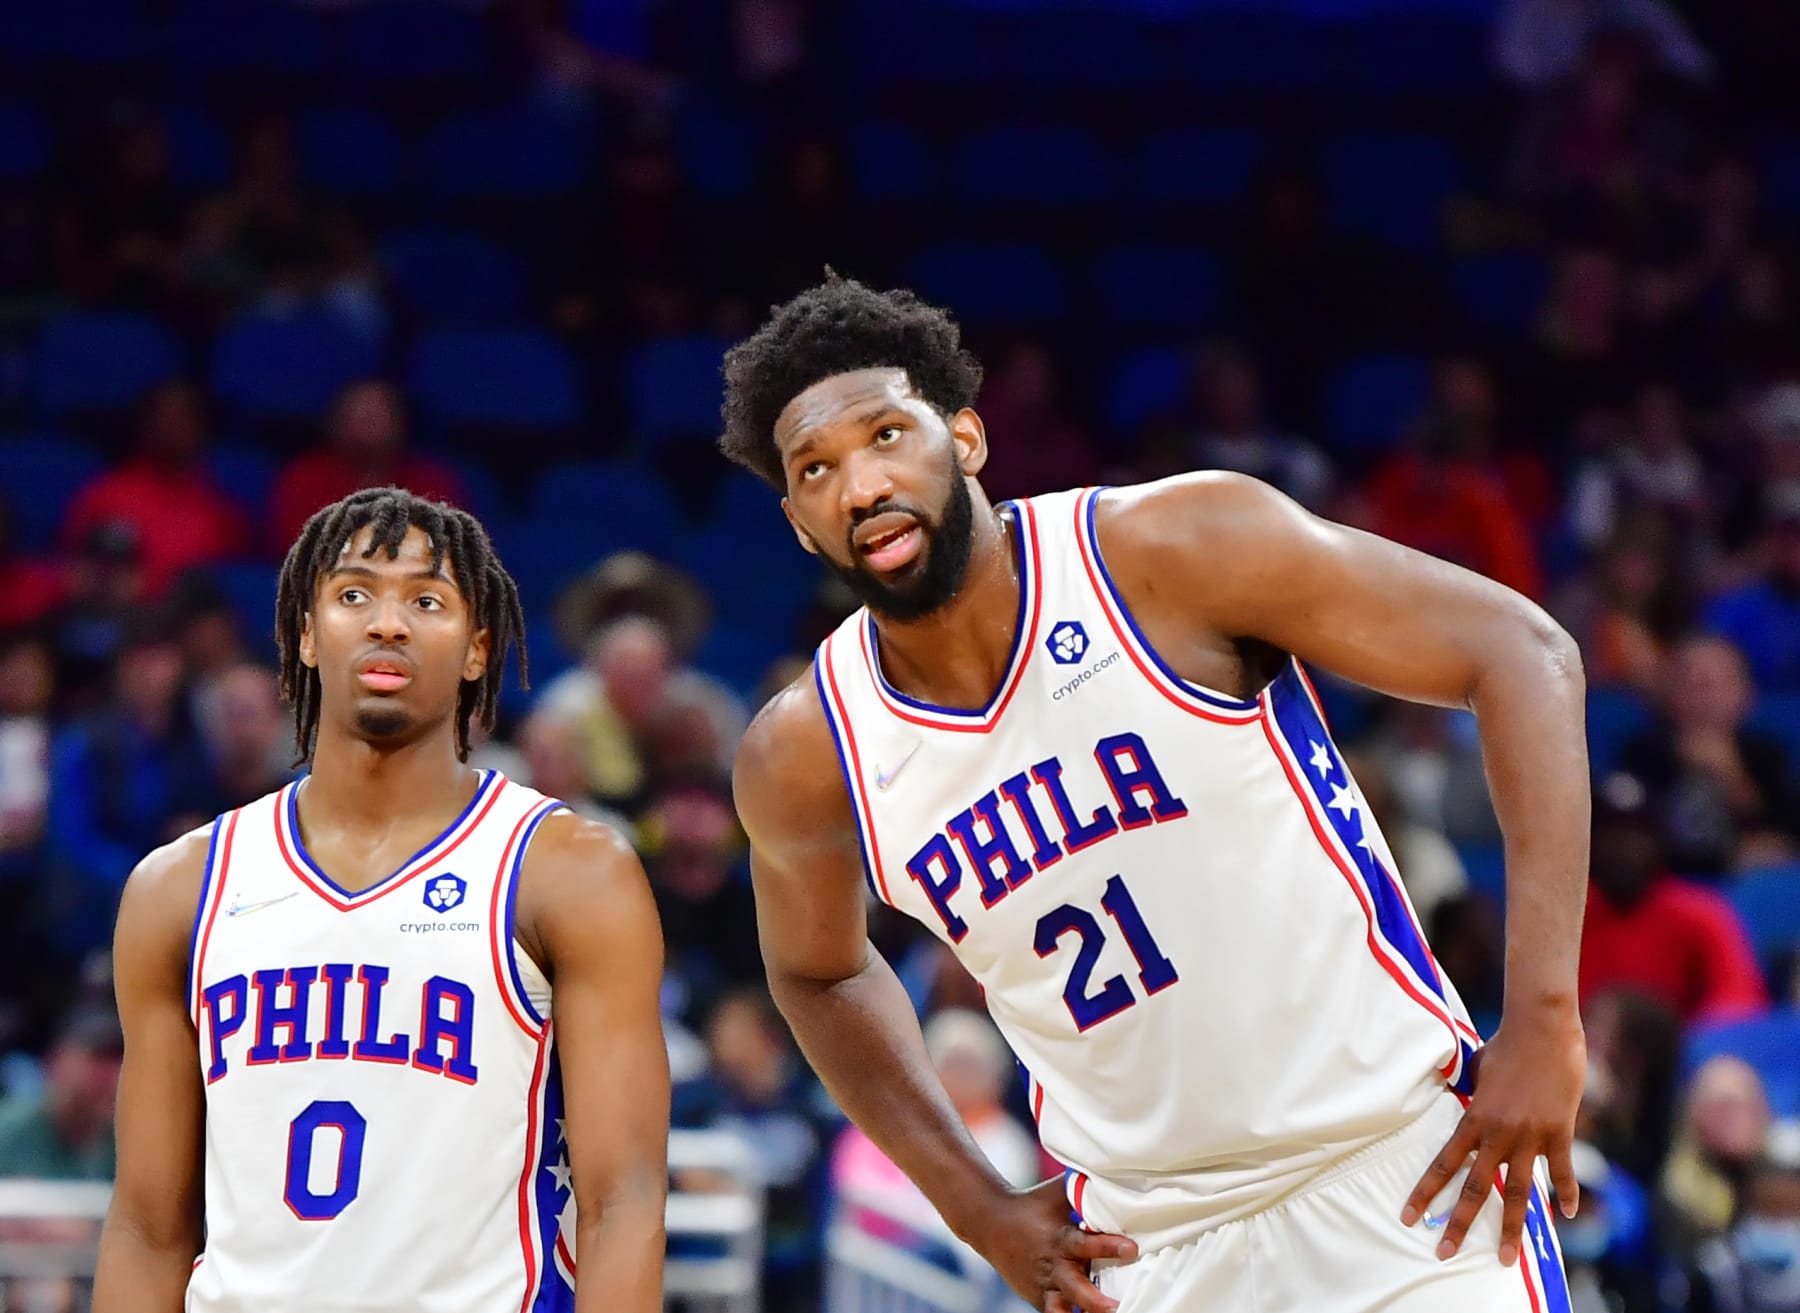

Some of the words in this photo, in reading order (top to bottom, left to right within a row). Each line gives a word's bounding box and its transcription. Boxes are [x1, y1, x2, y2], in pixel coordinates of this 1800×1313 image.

[1052, 650, 1120, 701] crypto.com
[906, 732, 1188, 945] PHILA
[400, 921, 480, 933] crypto.com
[1033, 874, 1179, 1033] 21
[202, 964, 477, 1085] PHILA
[283, 1100, 367, 1221] 0
